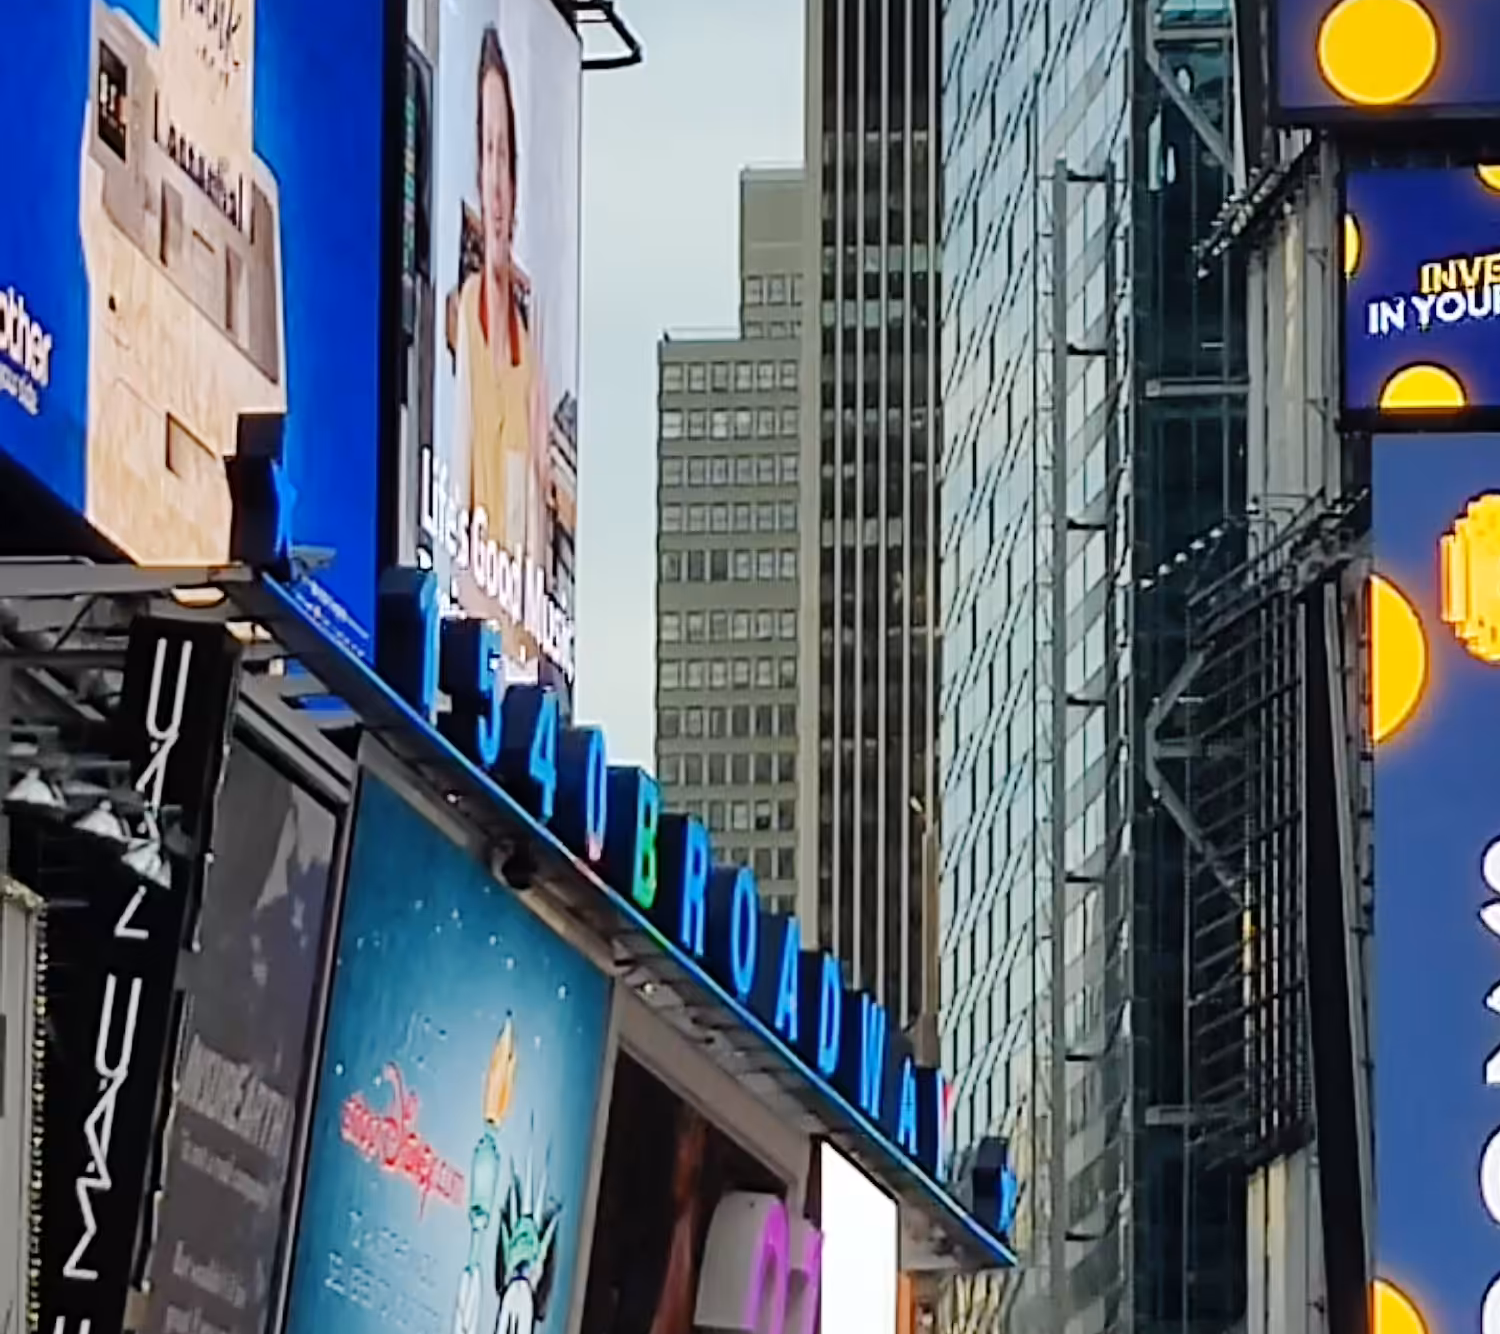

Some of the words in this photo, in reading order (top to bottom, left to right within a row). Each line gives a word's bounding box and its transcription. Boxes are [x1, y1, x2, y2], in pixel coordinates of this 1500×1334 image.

[1368, 294, 1405, 334] IN
[471, 505, 521, 624] Good
[418, 572, 608, 863] 1540
[631, 775, 956, 1185] BROADWAY
